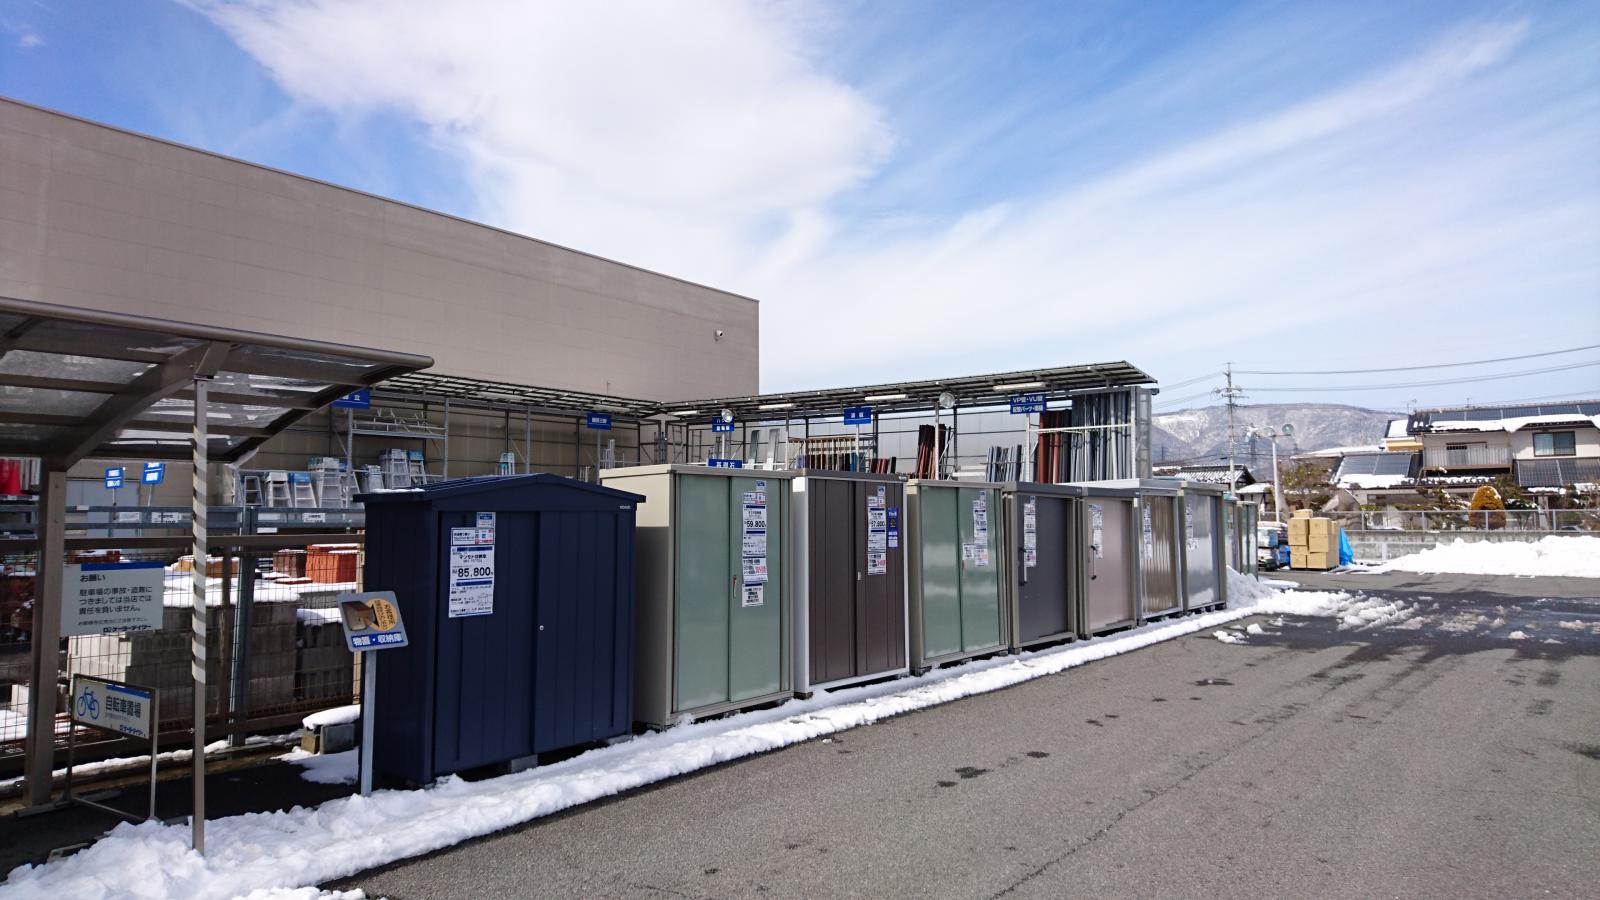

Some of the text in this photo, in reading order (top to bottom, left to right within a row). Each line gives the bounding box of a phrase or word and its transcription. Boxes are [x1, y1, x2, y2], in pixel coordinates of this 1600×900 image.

[457, 567, 491, 577] 85,800
[80, 574, 106, 583] お願い
[80, 586, 153, 596] 駐車場の事故・盗難に
[79, 595, 152, 605] つきましては当店では
[105, 695, 142, 718] 自転車置場
